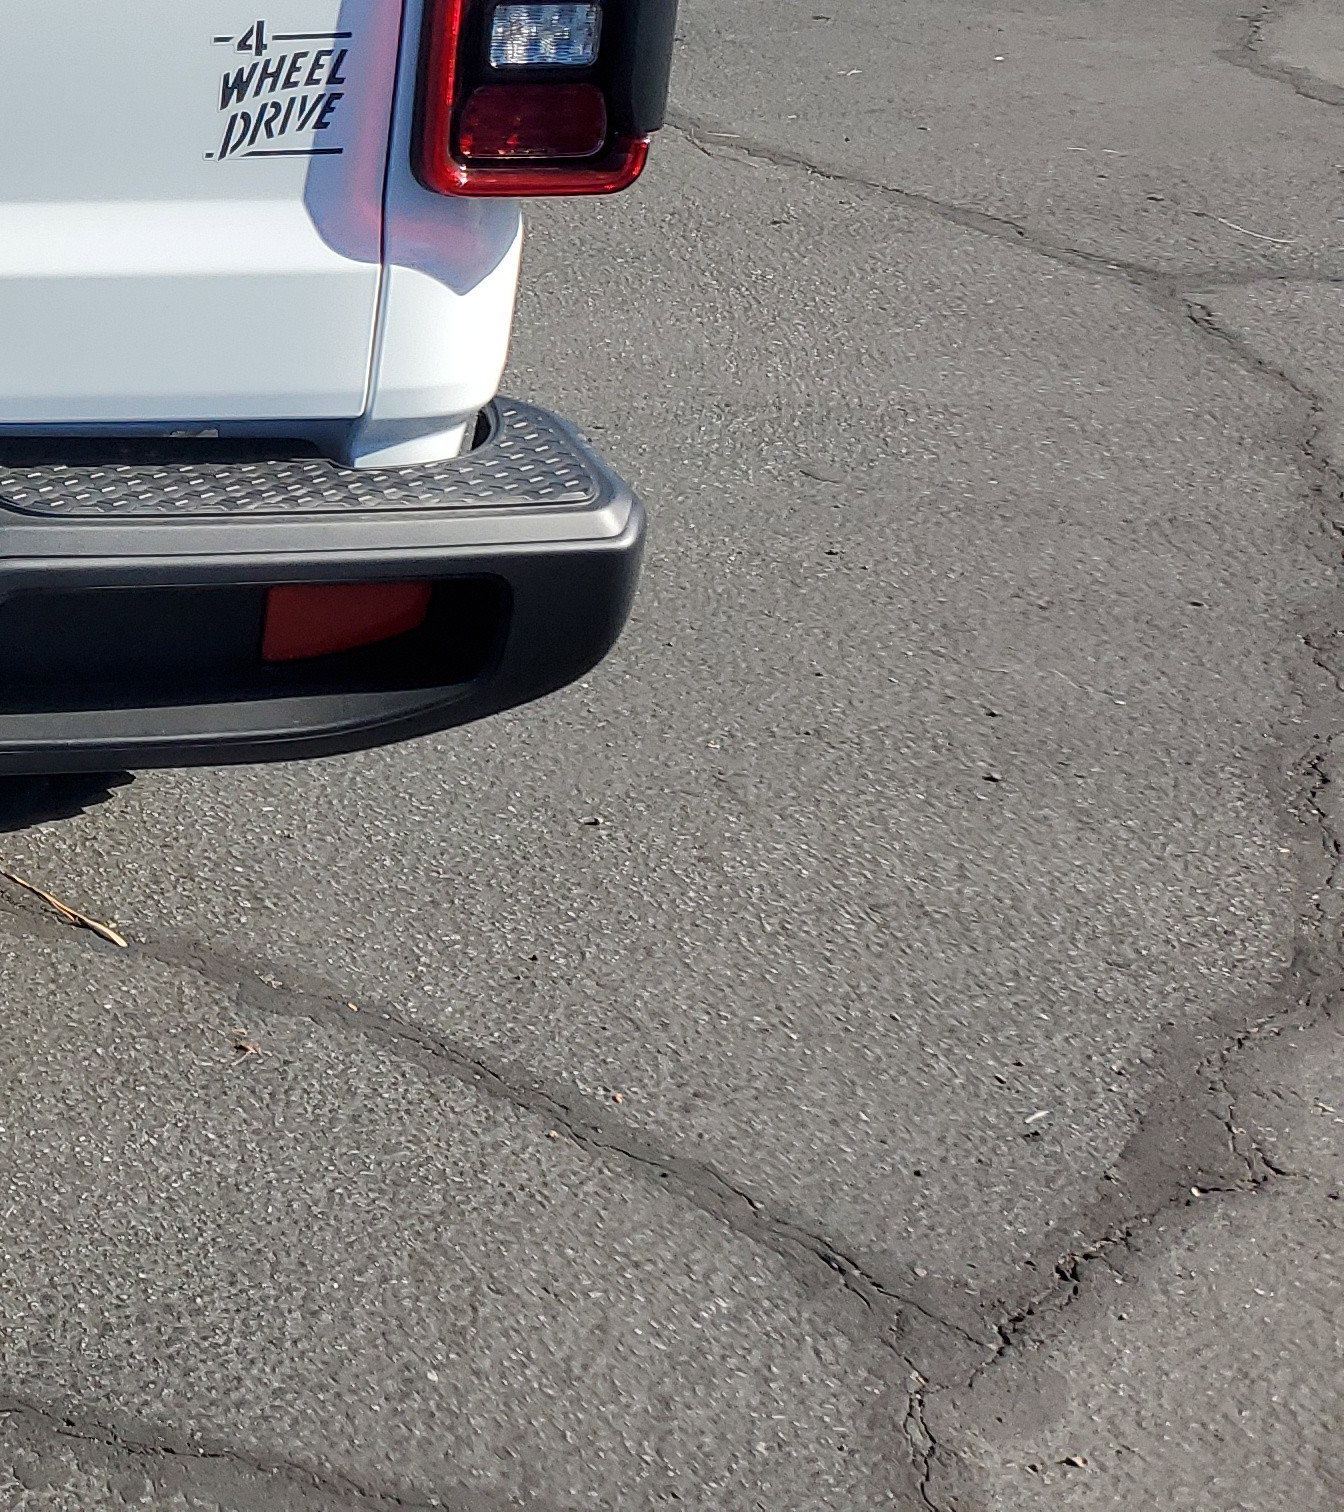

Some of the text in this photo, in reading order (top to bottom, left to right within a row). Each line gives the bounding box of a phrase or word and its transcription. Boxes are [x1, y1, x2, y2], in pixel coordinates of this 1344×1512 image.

[237, 20, 268, 56] 4
[220, 49, 348, 110] WHEEL
[218, 93, 344, 161] DRIVE
